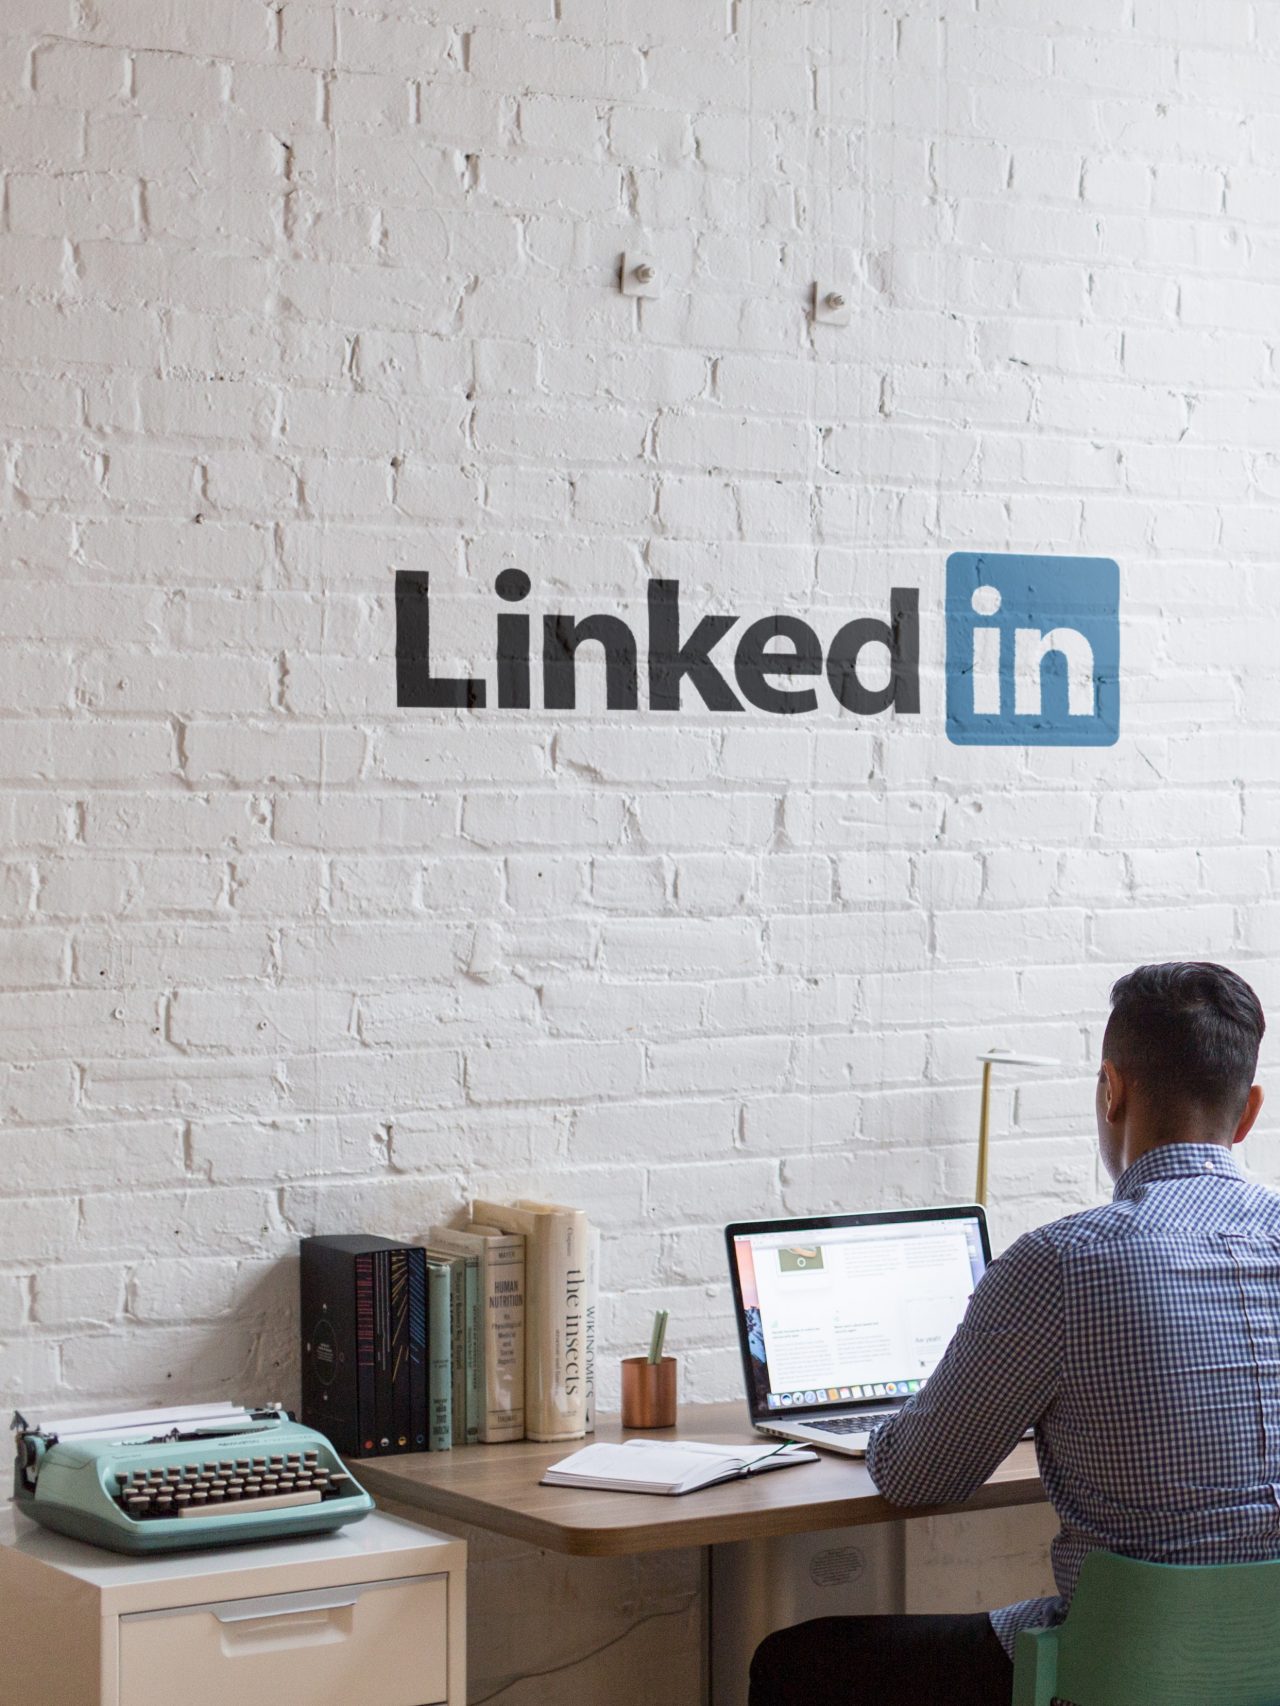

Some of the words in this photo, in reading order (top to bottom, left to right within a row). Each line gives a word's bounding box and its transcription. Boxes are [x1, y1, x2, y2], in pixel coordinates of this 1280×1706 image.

[395, 568, 921, 715] Linked
[971, 585, 1095, 716] in
[489, 1294, 523, 1309] NUTRITION
[494, 1281, 519, 1294] HUMAN
[566, 1270, 584, 1308] the
[565, 1314, 582, 1396] insects
[585, 1305, 595, 1399] WIKINOMICS
